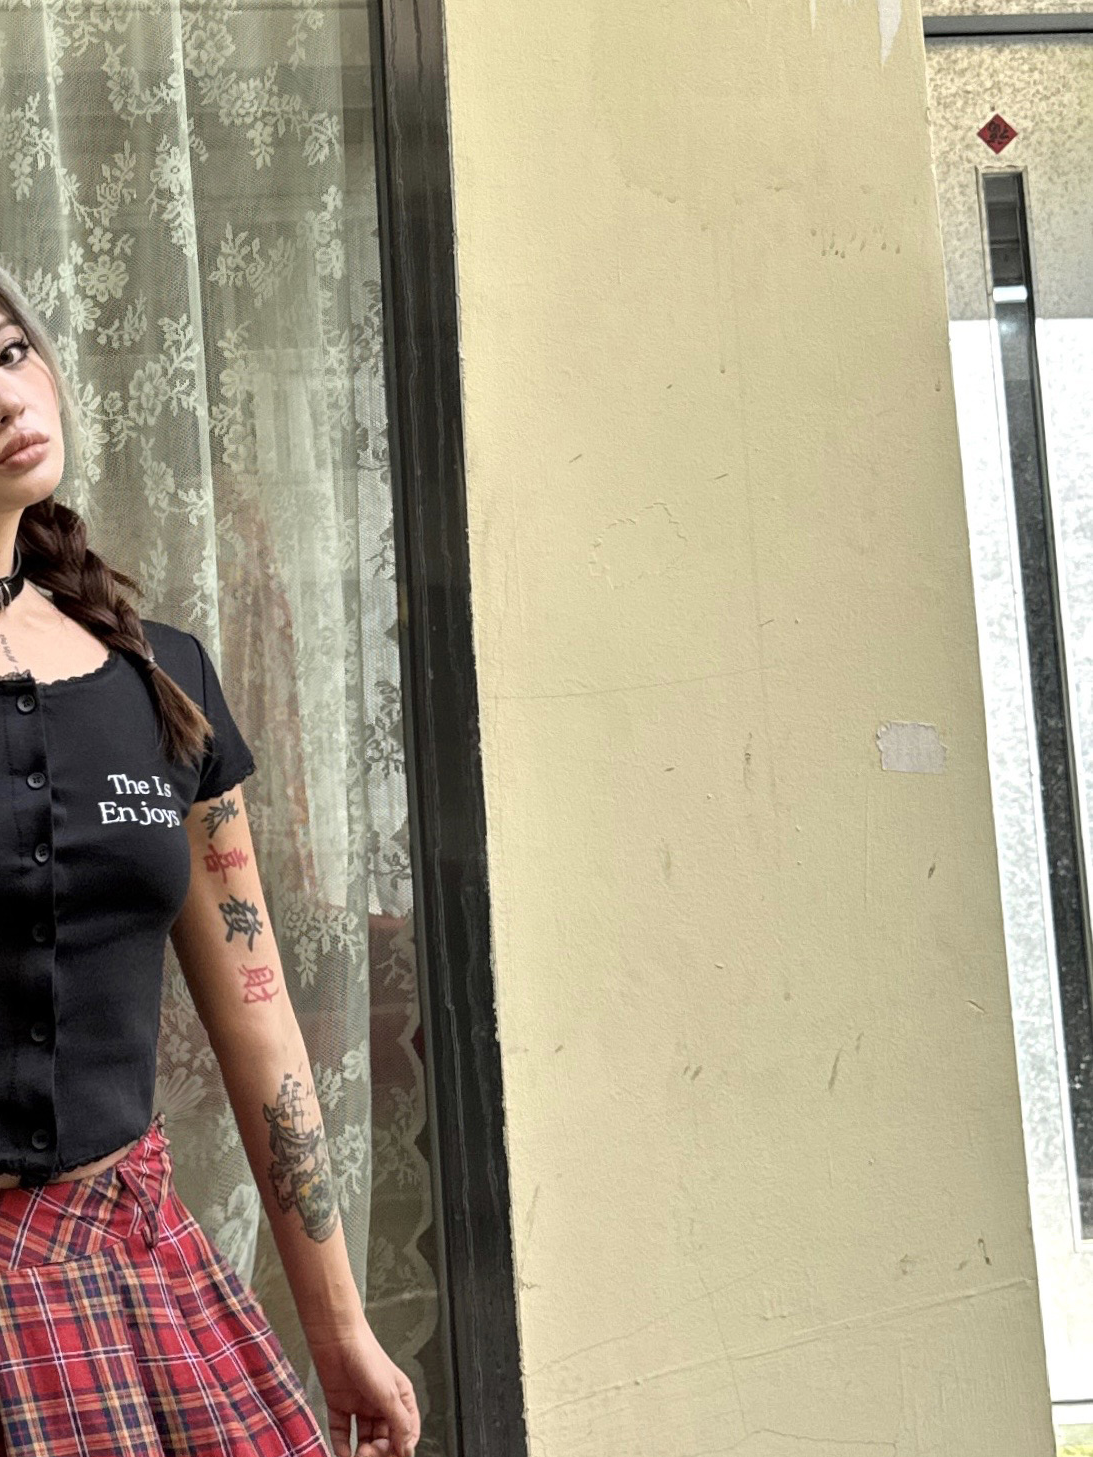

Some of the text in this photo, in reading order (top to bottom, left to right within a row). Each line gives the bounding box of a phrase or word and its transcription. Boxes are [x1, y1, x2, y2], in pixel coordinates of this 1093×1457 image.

[107, 773, 172, 798] The Is
[97, 800, 181, 828] Enjoys
